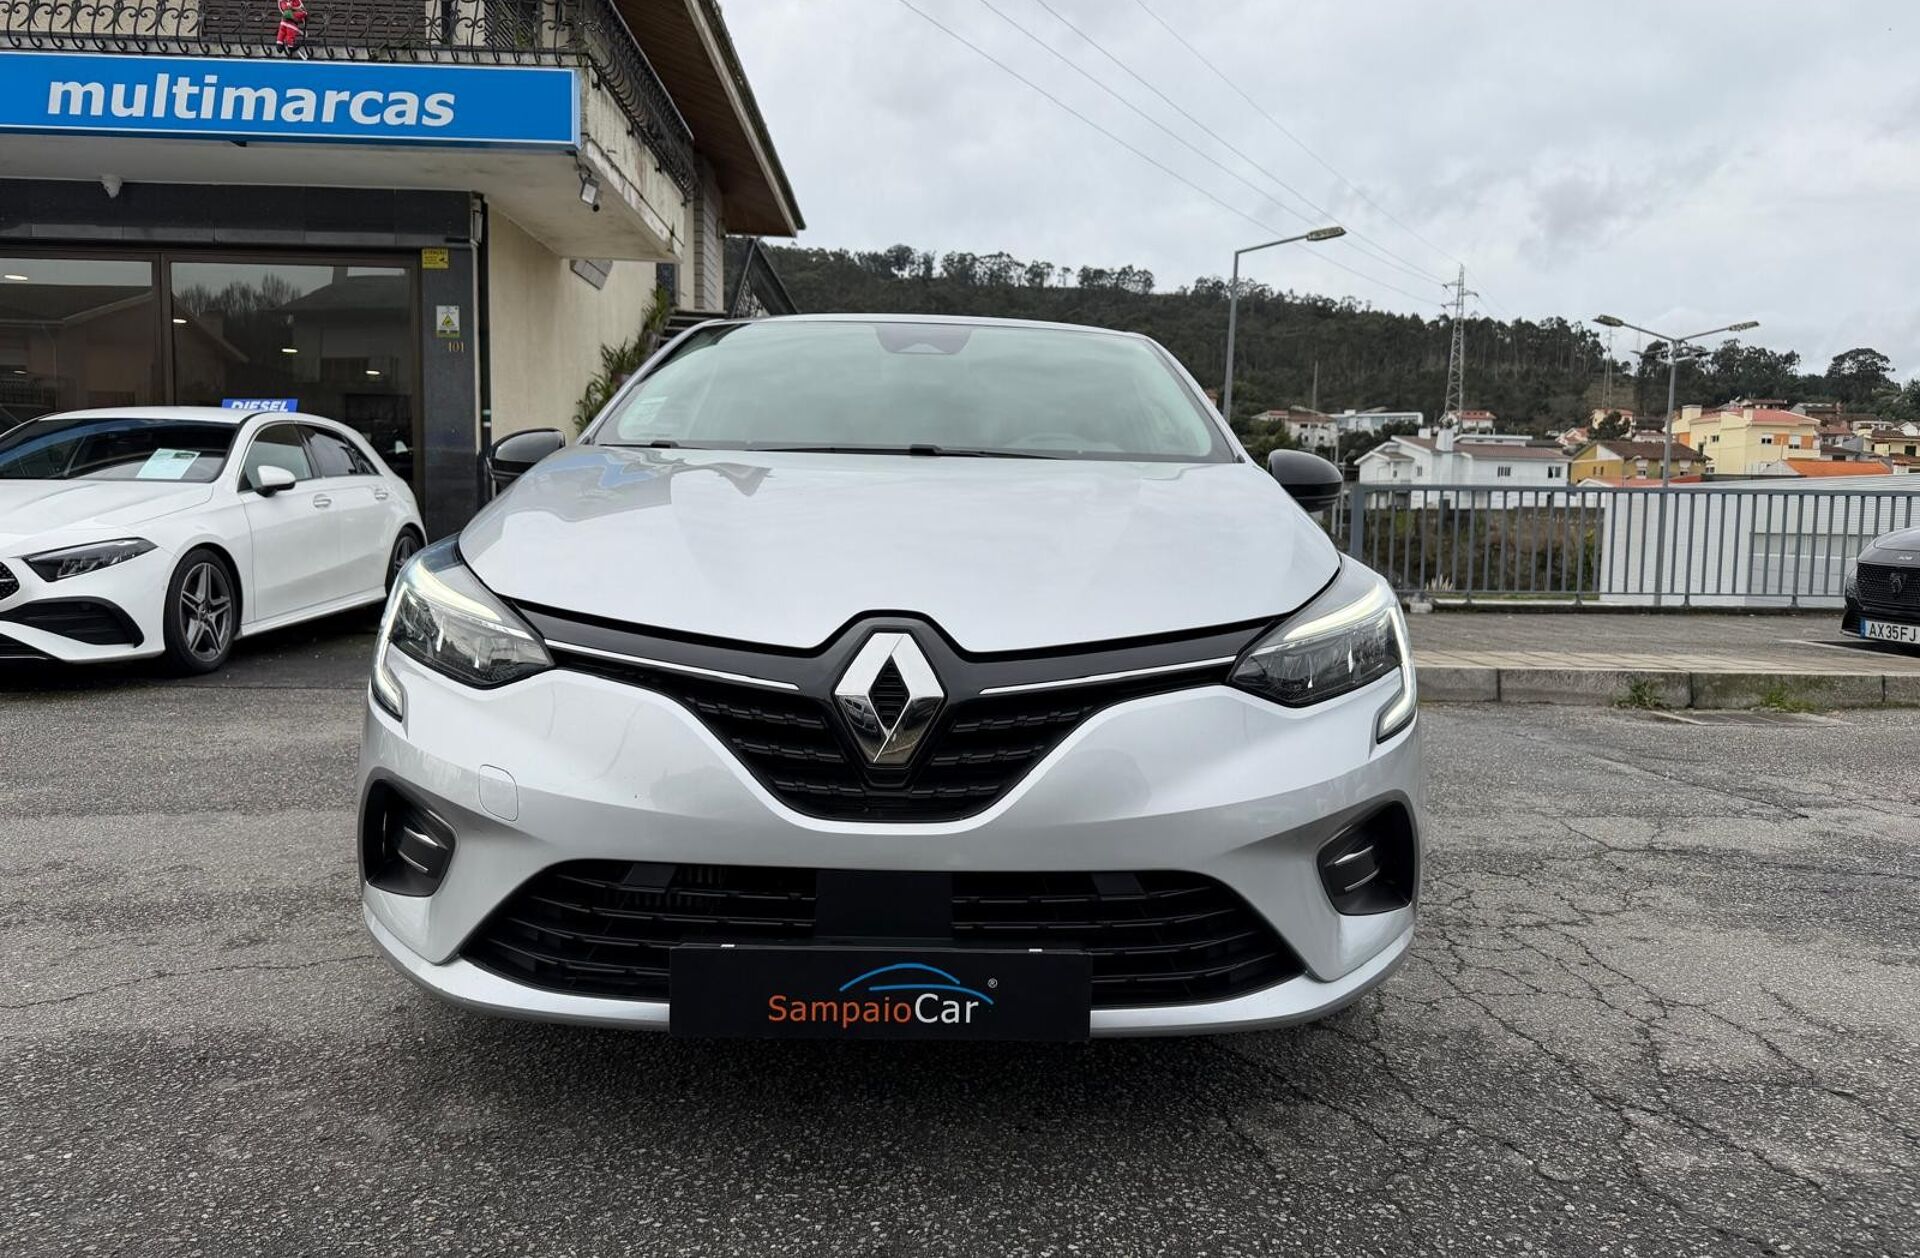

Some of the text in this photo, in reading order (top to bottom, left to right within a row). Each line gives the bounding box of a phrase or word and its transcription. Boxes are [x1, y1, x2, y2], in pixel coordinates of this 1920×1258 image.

[47, 73, 455, 126] multimarcas
[231, 400, 289, 412] DIESEL
[768, 993, 979, 1029] SampaioCar
